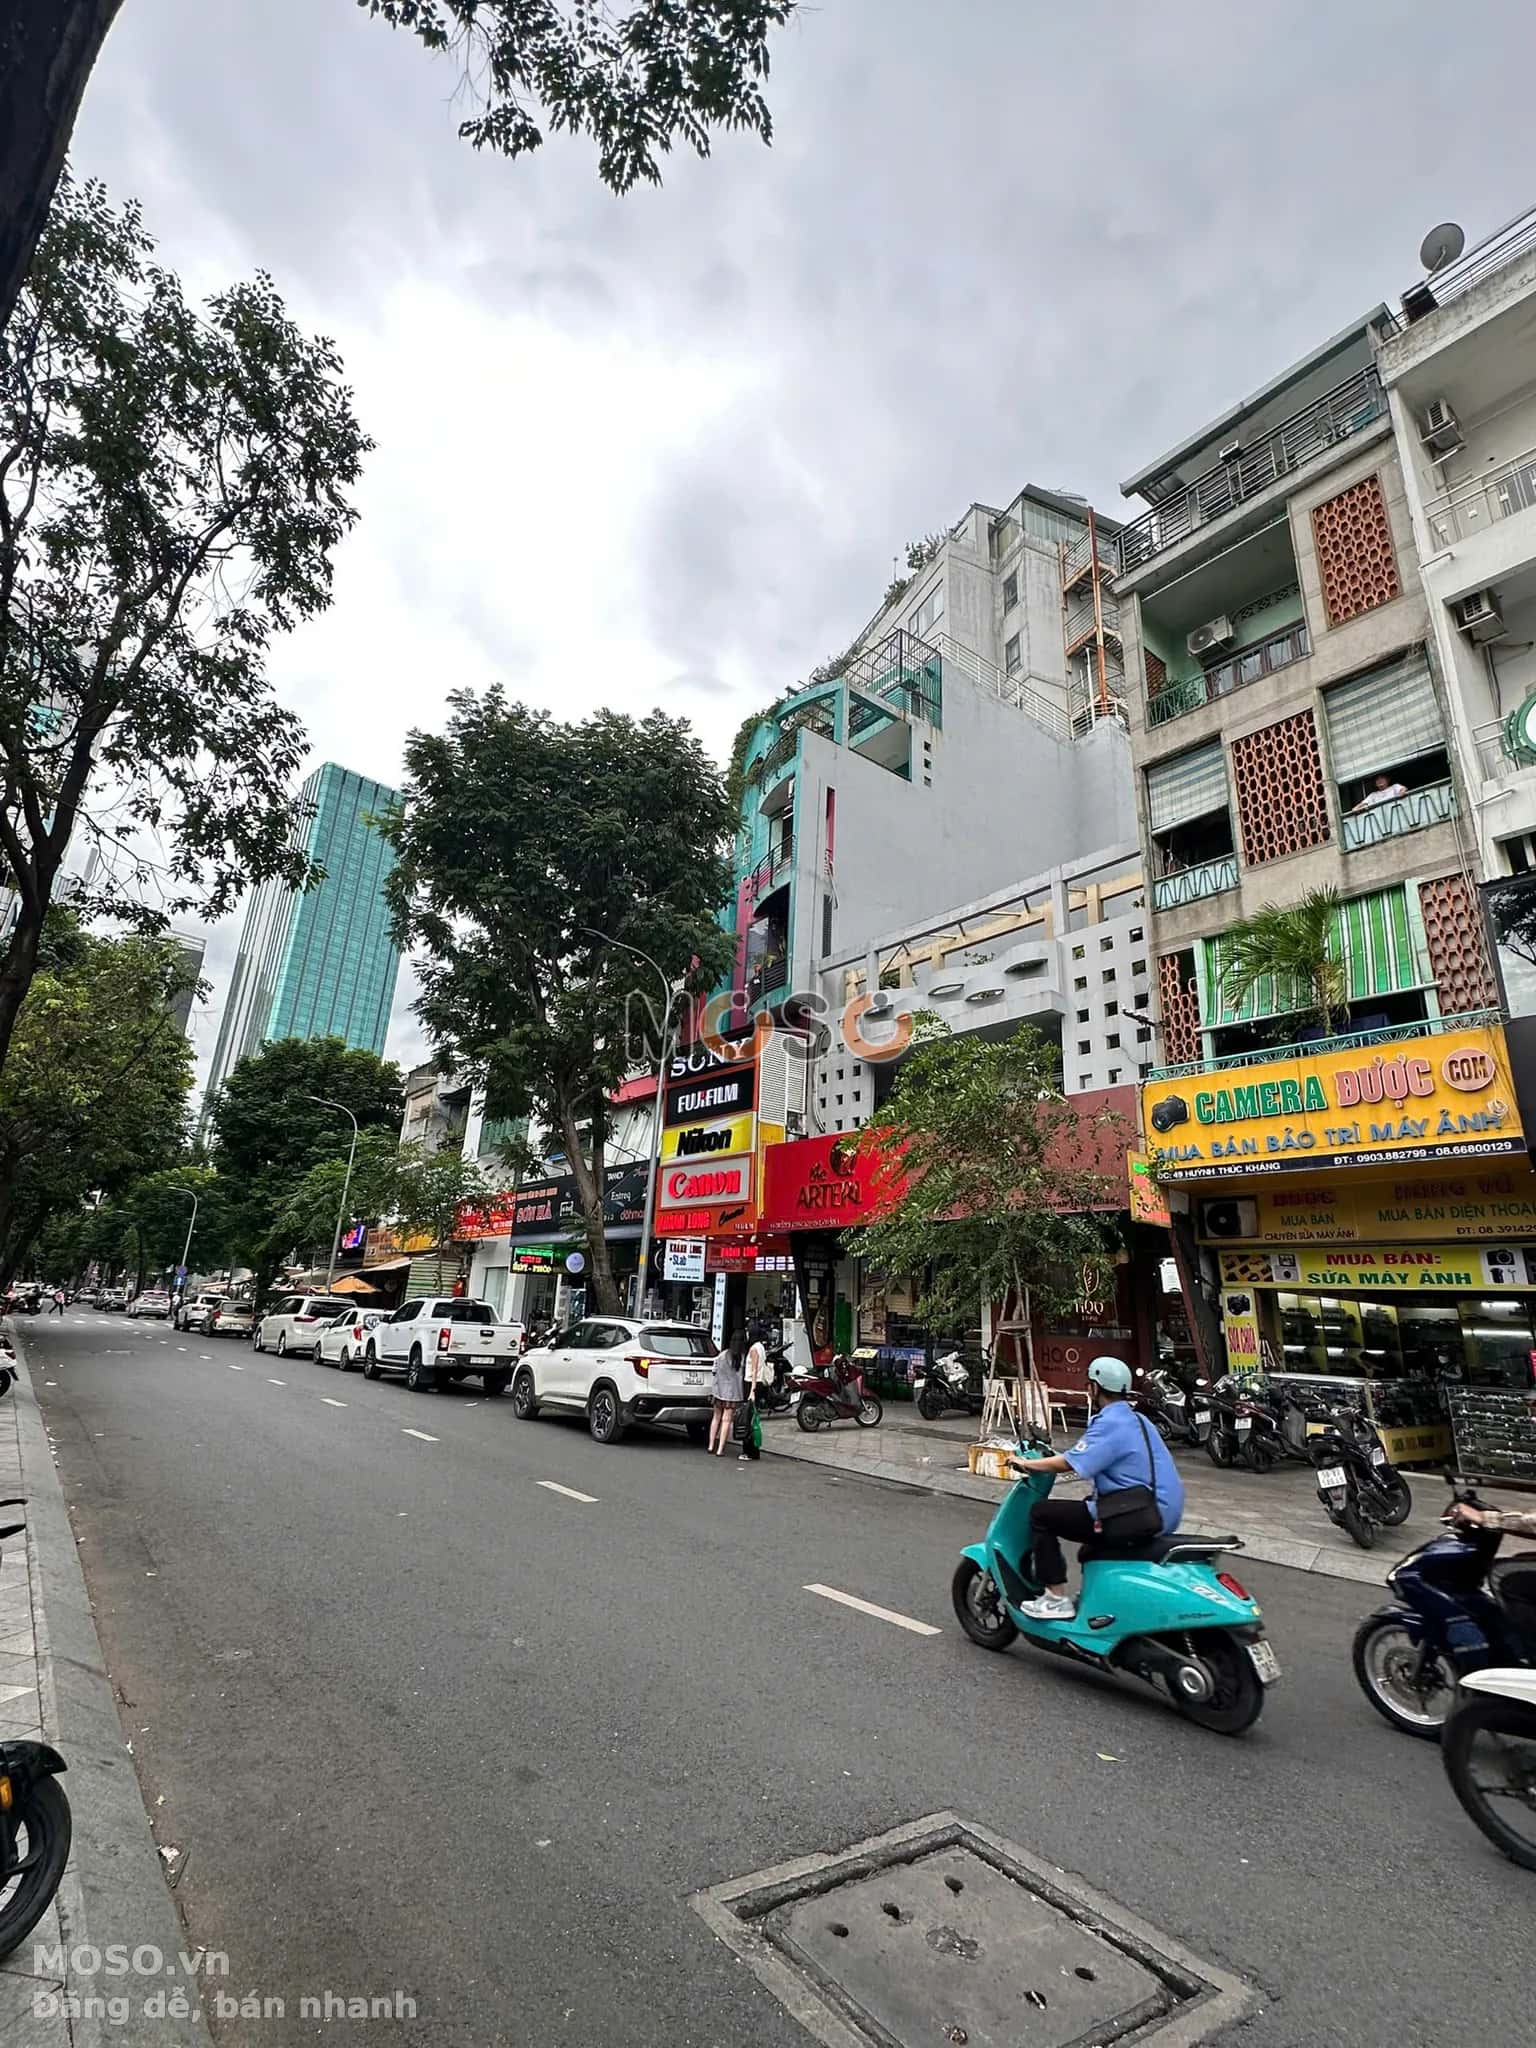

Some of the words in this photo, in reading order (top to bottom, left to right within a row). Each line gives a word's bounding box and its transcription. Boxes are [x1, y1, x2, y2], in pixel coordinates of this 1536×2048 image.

[677, 1083, 739, 1114] FUJIFILM
[1194, 1074, 1328, 1125] CAMERA
[1334, 1053, 1435, 1109] ĐƯỢC
[1448, 1055, 1489, 1083] COM
[676, 1126, 733, 1157] Nikon
[1156, 1144, 1204, 1162] MUA
[1211, 1135, 1258, 1158] BÁN
[1266, 1127, 1315, 1152] BẢO
[1325, 1120, 1361, 1147] TRÌ
[1370, 1115, 1430, 1142] MÁY
[1436, 1108, 1504, 1136] ẢNH
[1334, 1156, 1353, 1165] ĐT:
[1356, 1148, 1427, 1164] 0903.882799
[1435, 1141, 1513, 1156] 08.66800129
[1218, 1162, 1243, 1176] THÚC
[1245, 1161, 1281, 1174] KHÁNG
[667, 1168, 741, 1200] Canon
[687, 1211, 711, 1230] LONG
[1281, 1214, 1307, 1227] MUA
[1376, 1208, 1409, 1222] MUA
[1456, 1226, 1474, 1235] ĐT:
[1326, 1253, 1377, 1266] MUA
[1383, 1250, 1442, 1266] BÁN:
[1307, 1270, 1352, 1285] SỬA
[1358, 1270, 1411, 1285] MÁY
[1419, 1267, 1472, 1285] ẢNH
